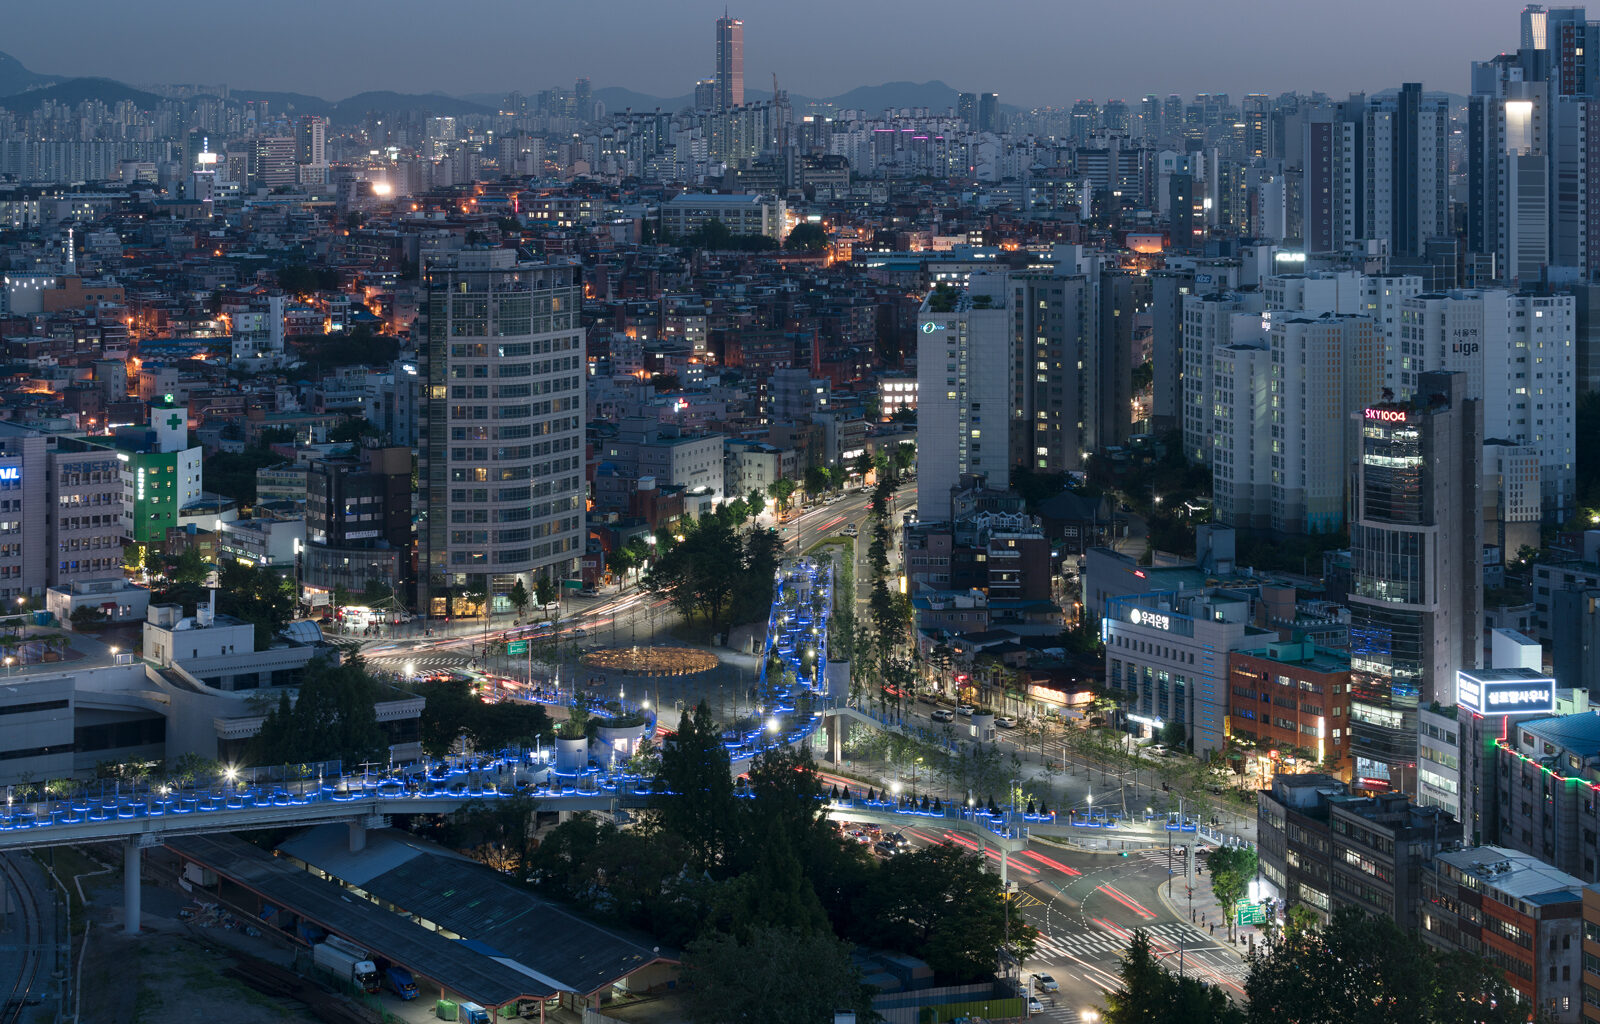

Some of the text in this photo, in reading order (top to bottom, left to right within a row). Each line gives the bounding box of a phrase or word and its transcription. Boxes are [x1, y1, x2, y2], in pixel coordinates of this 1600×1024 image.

[1453, 329, 1477, 337] 서울역
[1453, 339, 1478, 356] Liga
[1365, 408, 1405, 421] SKY1004
[1141, 611, 1168, 630] 우리은행
